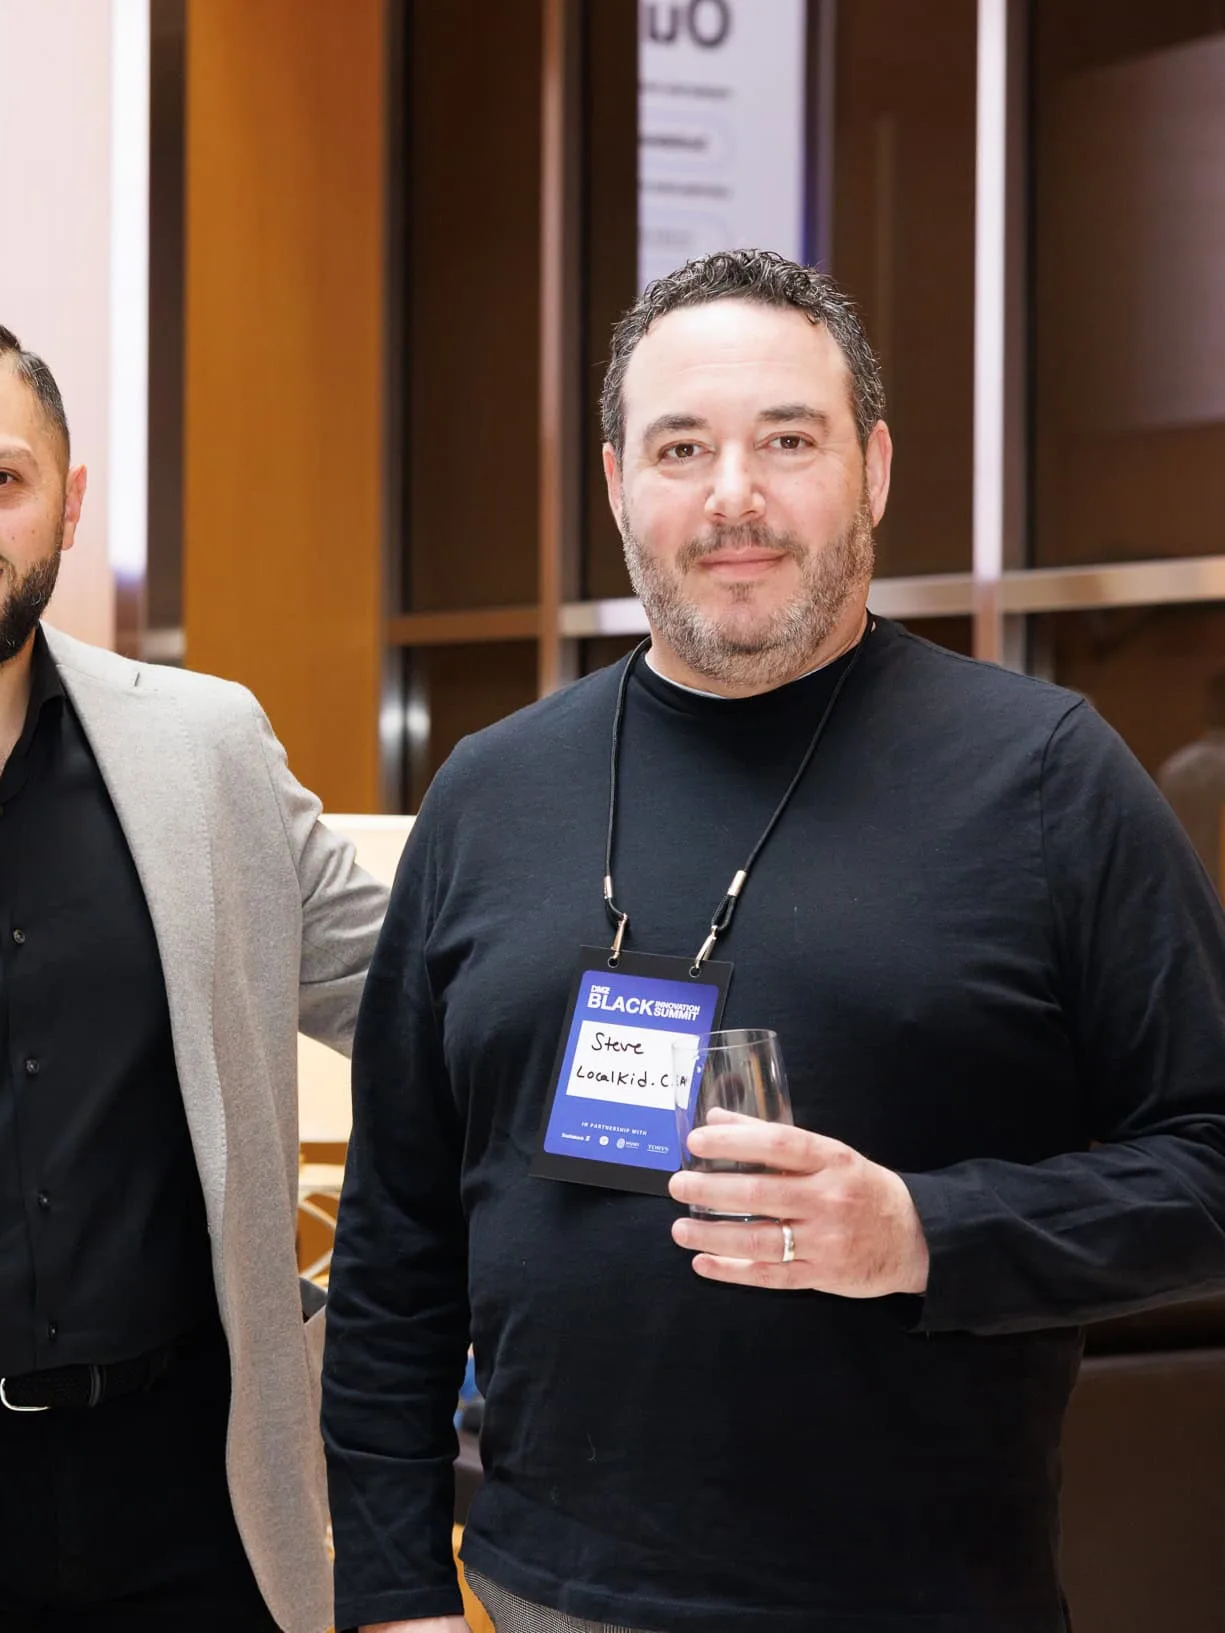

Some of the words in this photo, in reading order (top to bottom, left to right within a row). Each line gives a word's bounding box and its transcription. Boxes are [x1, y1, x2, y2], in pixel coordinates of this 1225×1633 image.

[587, 992, 655, 1016] BLACK
[655, 1000, 700, 1014] INNOVATION
[653, 1007, 697, 1021] SUMMIT
[591, 1032, 644, 1054] Steve
